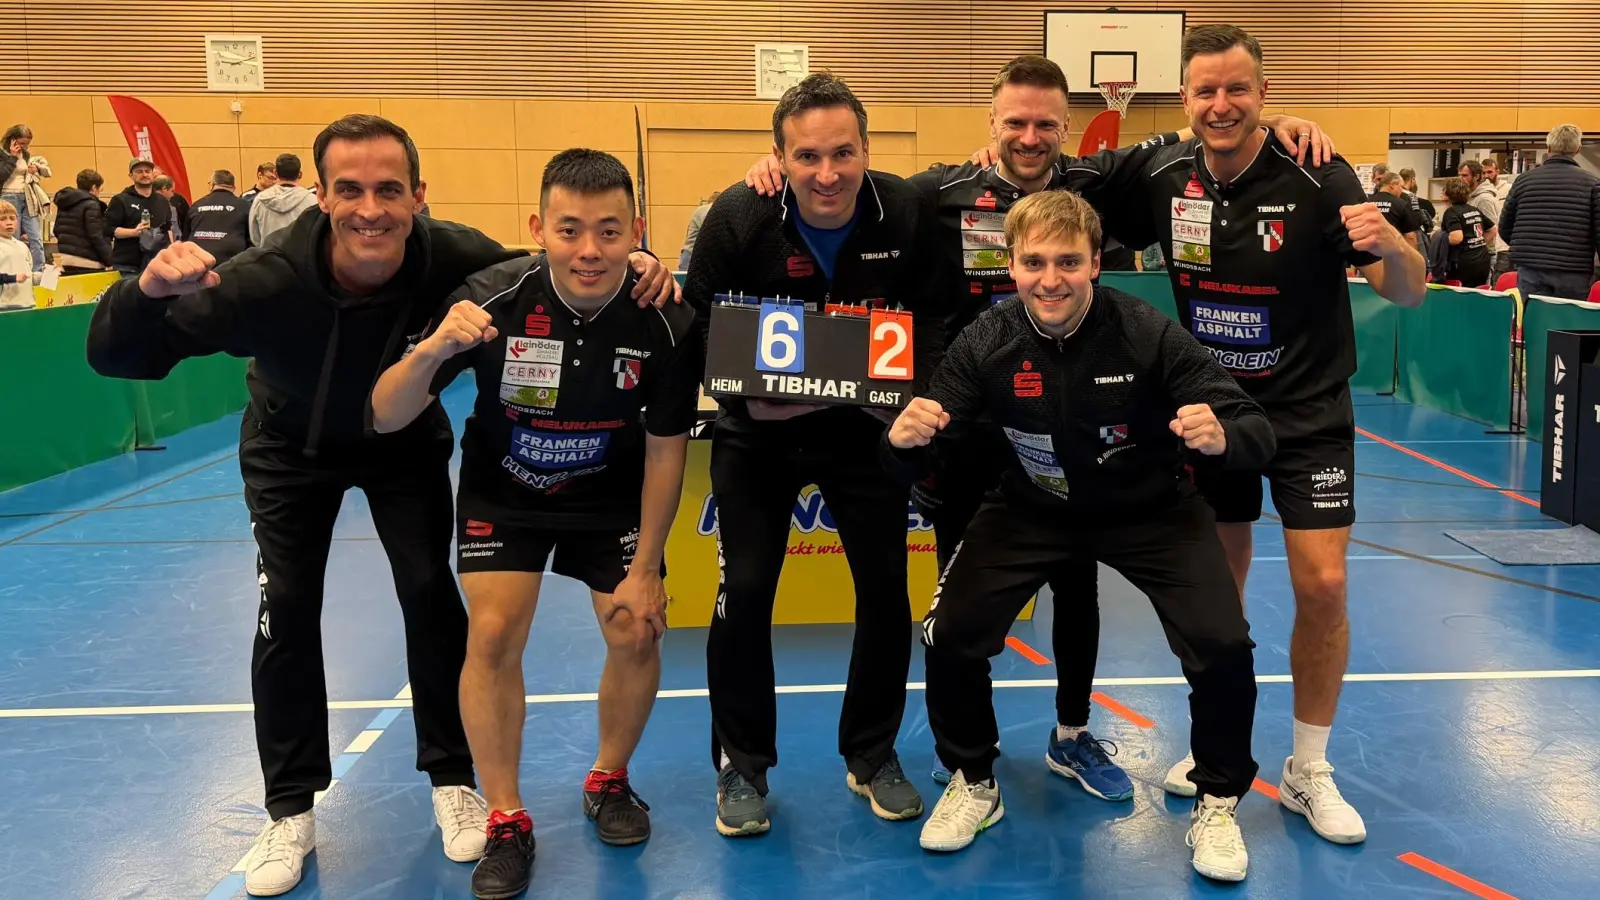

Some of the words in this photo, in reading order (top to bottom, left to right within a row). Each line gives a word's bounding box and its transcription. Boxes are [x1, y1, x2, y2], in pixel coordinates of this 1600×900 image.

[1257, 205, 1285, 213] TIBHAR
[1173, 224, 1208, 236] CERNY
[965, 234, 1005, 244] CERNY
[861, 252, 889, 260] TIBHAR
[1173, 261, 1211, 272] WINDSBACH
[1199, 280, 1280, 295] HELUKABEL
[1195, 306, 1261, 323] FRANKEN
[1197, 322, 1261, 339] ASPHALT
[760, 311, 800, 369] 6
[615, 347, 643, 358] TIBHAR
[873, 321, 908, 377] 2
[1202, 346, 1281, 370] NGLEIN
[507, 366, 557, 379] CERNY
[1094, 375, 1124, 385] TIBHAR
[711, 378, 743, 393] HEIM
[762, 374, 859, 399] TIBHAR
[869, 391, 901, 405] GAST
[500, 399, 554, 416] WINDSBACH
[531, 418, 626, 431] HELUKABEL
[520, 433, 601, 449] FRANKEN
[1552, 393, 1565, 483] TIBHAR
[519, 447, 598, 463] ASPHALT
[816, 541, 845, 554] wie
